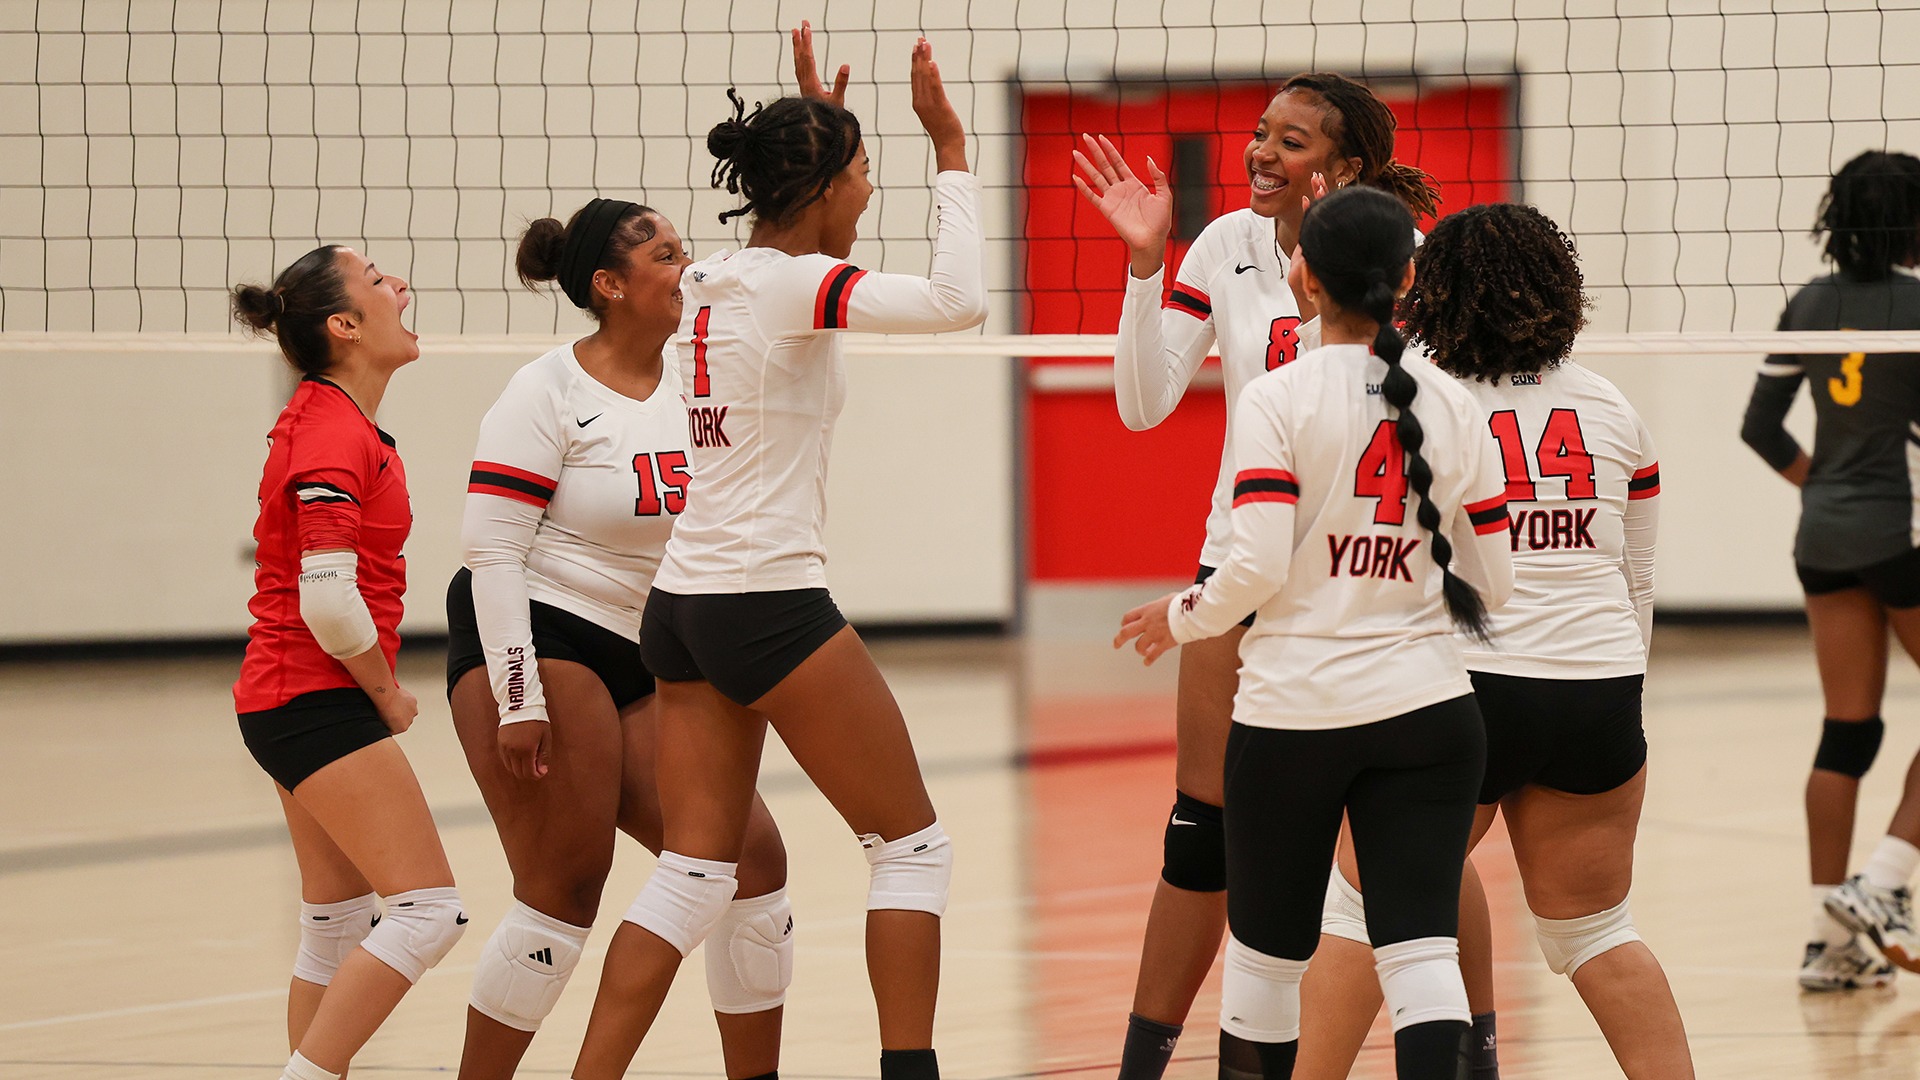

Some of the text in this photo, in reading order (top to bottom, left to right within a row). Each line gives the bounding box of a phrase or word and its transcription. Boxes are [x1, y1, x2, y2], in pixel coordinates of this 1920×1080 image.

[691, 305, 711, 397] 1
[1265, 316, 1302, 372] 8
[1511, 374, 1542, 386] CUNY
[632, 450, 693, 516] 15
[1354, 419, 1409, 527] 4
[1488, 408, 1598, 502] 14
[1327, 534, 1421, 583] YORK
[1508, 508, 1597, 551] YORK
